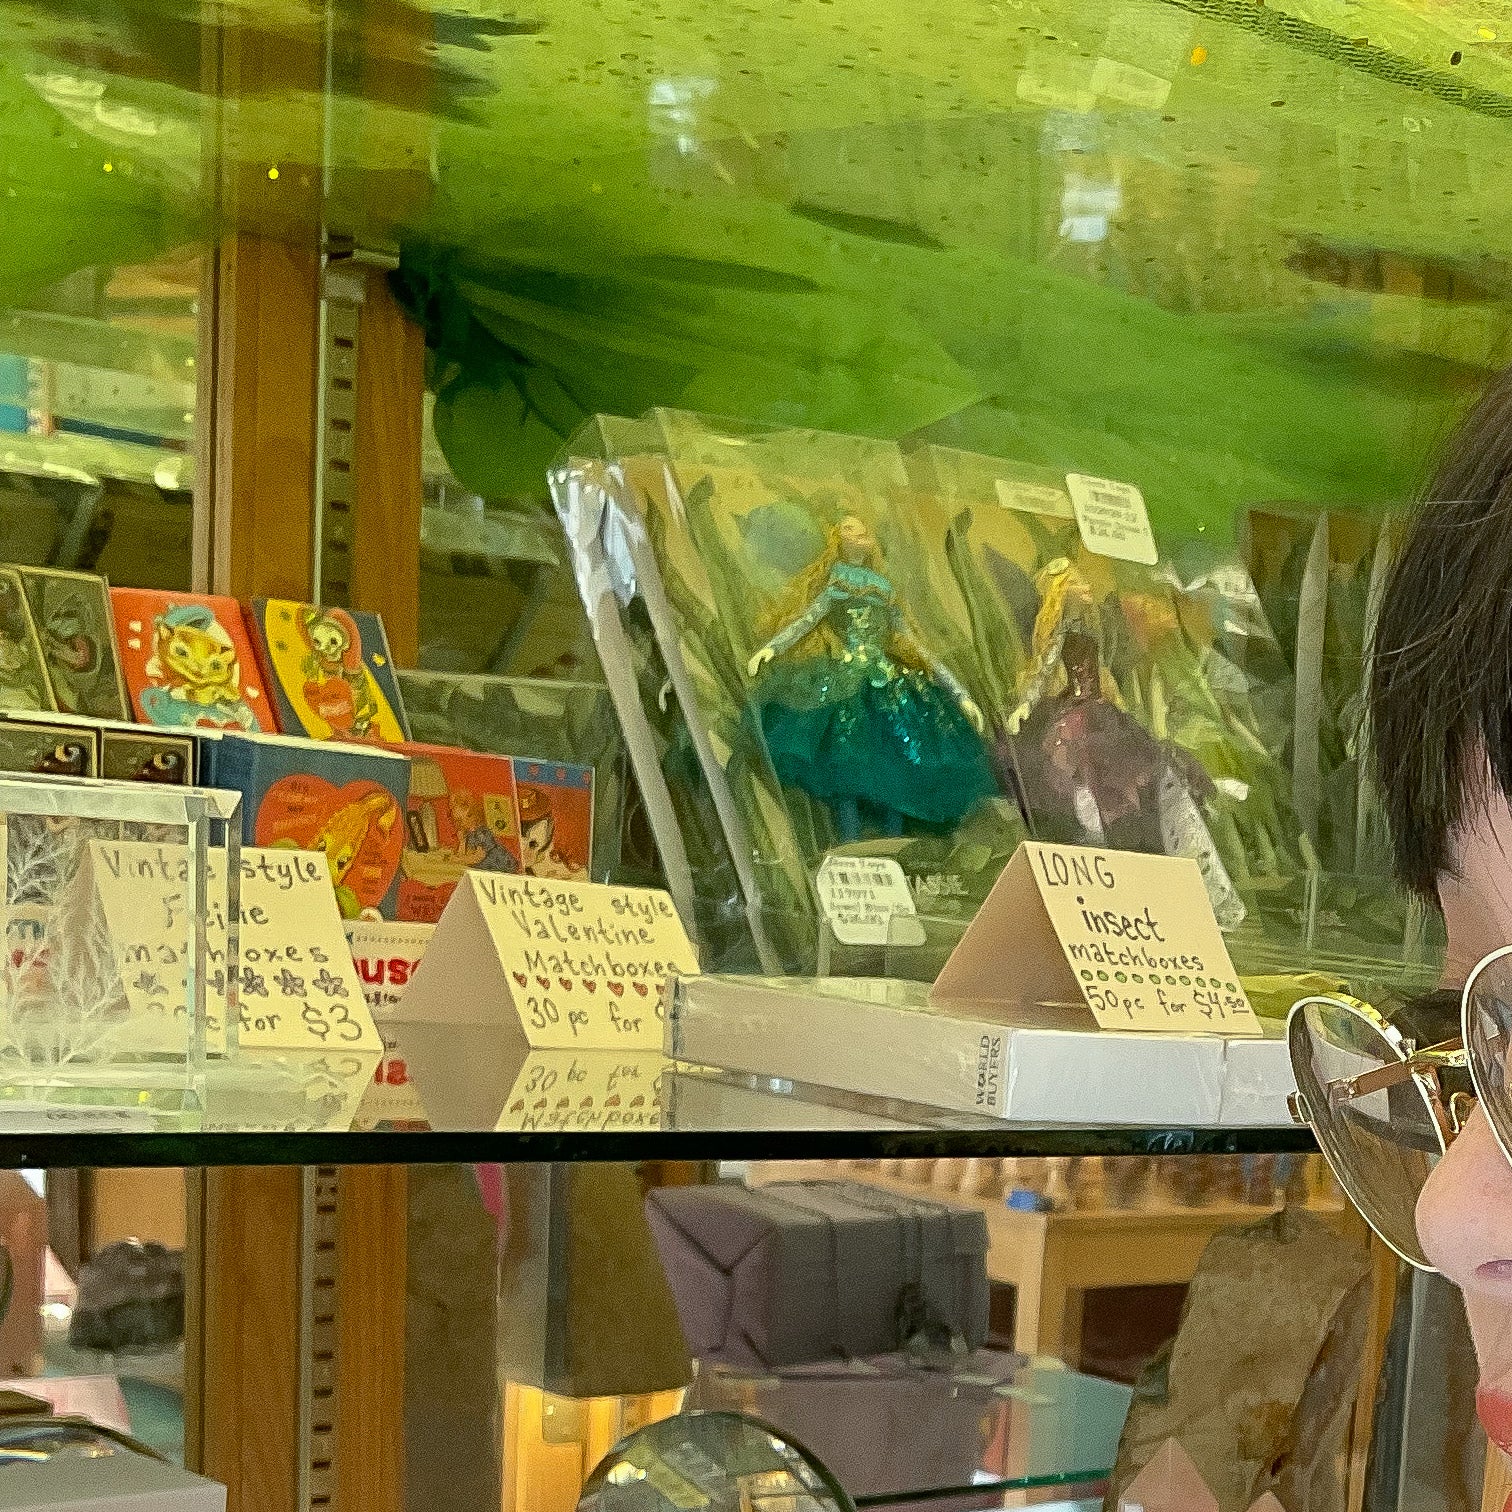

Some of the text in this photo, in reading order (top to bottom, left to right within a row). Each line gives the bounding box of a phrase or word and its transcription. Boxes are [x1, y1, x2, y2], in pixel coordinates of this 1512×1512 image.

[99, 847, 217, 882] Vintae
[240, 851, 323, 890] style
[1038, 850, 1115, 889] LONG
[480, 878, 583, 916] Vintage
[611, 896, 673, 924] style
[1076, 895, 1165, 942] insect
[511, 910, 655, 944] Valentine
[1068, 942, 1205, 971] matchboxes
[301, 1001, 363, 1042] $3
[527, 997, 560, 1030] 30
[568, 1009, 589, 1035] pc
[609, 1001, 643, 1034] for
[1156, 989, 1187, 1016] for
[975, 1035, 990, 1105] WORLD
[986, 1037, 1001, 1106] BUYERS
